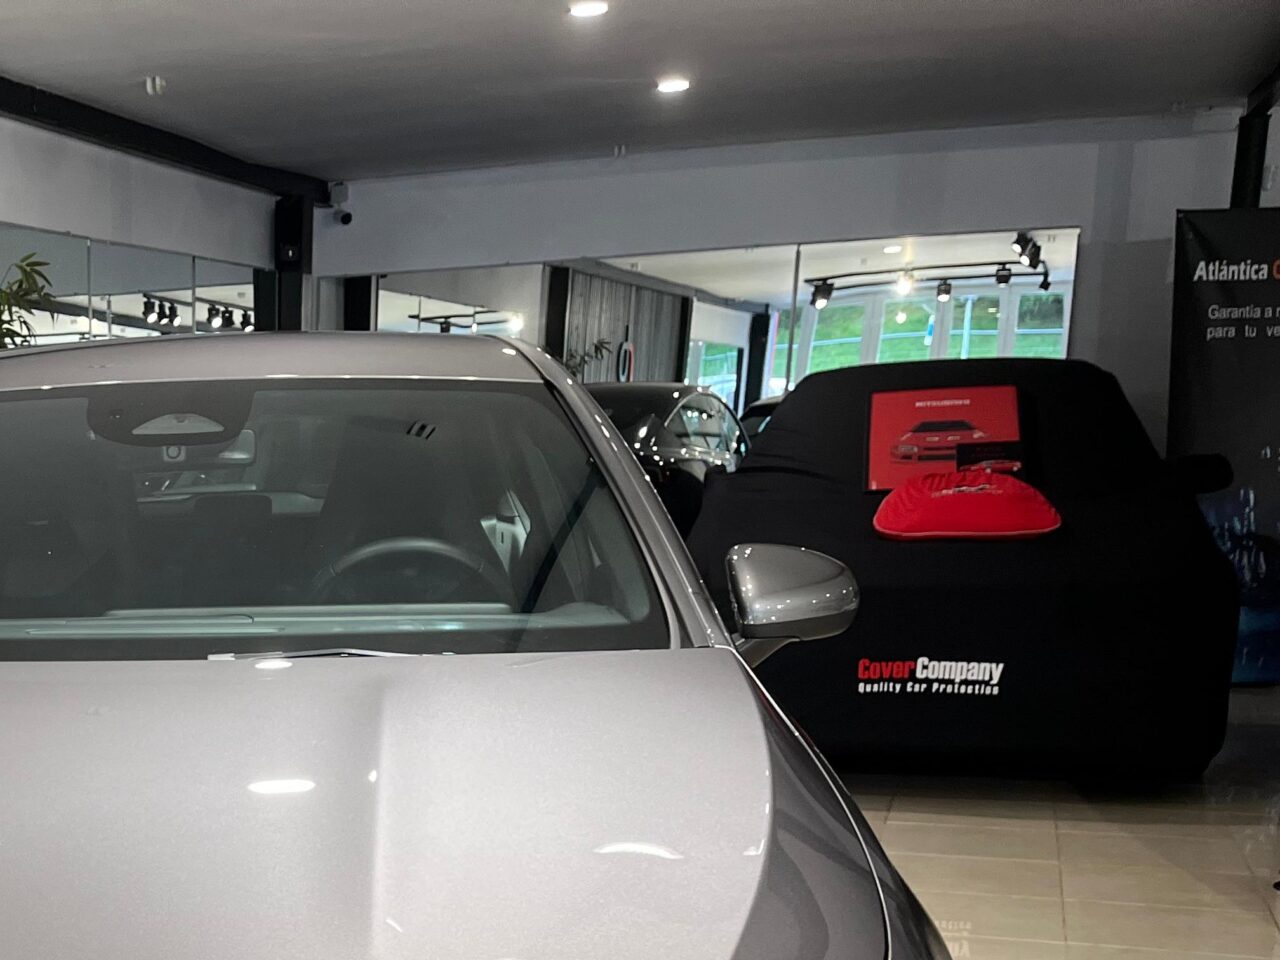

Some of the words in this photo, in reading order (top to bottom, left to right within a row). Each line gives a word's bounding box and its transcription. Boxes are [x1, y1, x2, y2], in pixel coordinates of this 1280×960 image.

[1193, 259, 1269, 282] Atlántica
[1264, 306, 1273, 318] a
[1206, 326, 1236, 341] para
[1245, 324, 1257, 338] tu
[858, 682, 901, 694] Quality
[906, 682, 927, 693] Car
[932, 682, 999, 695] Protection
